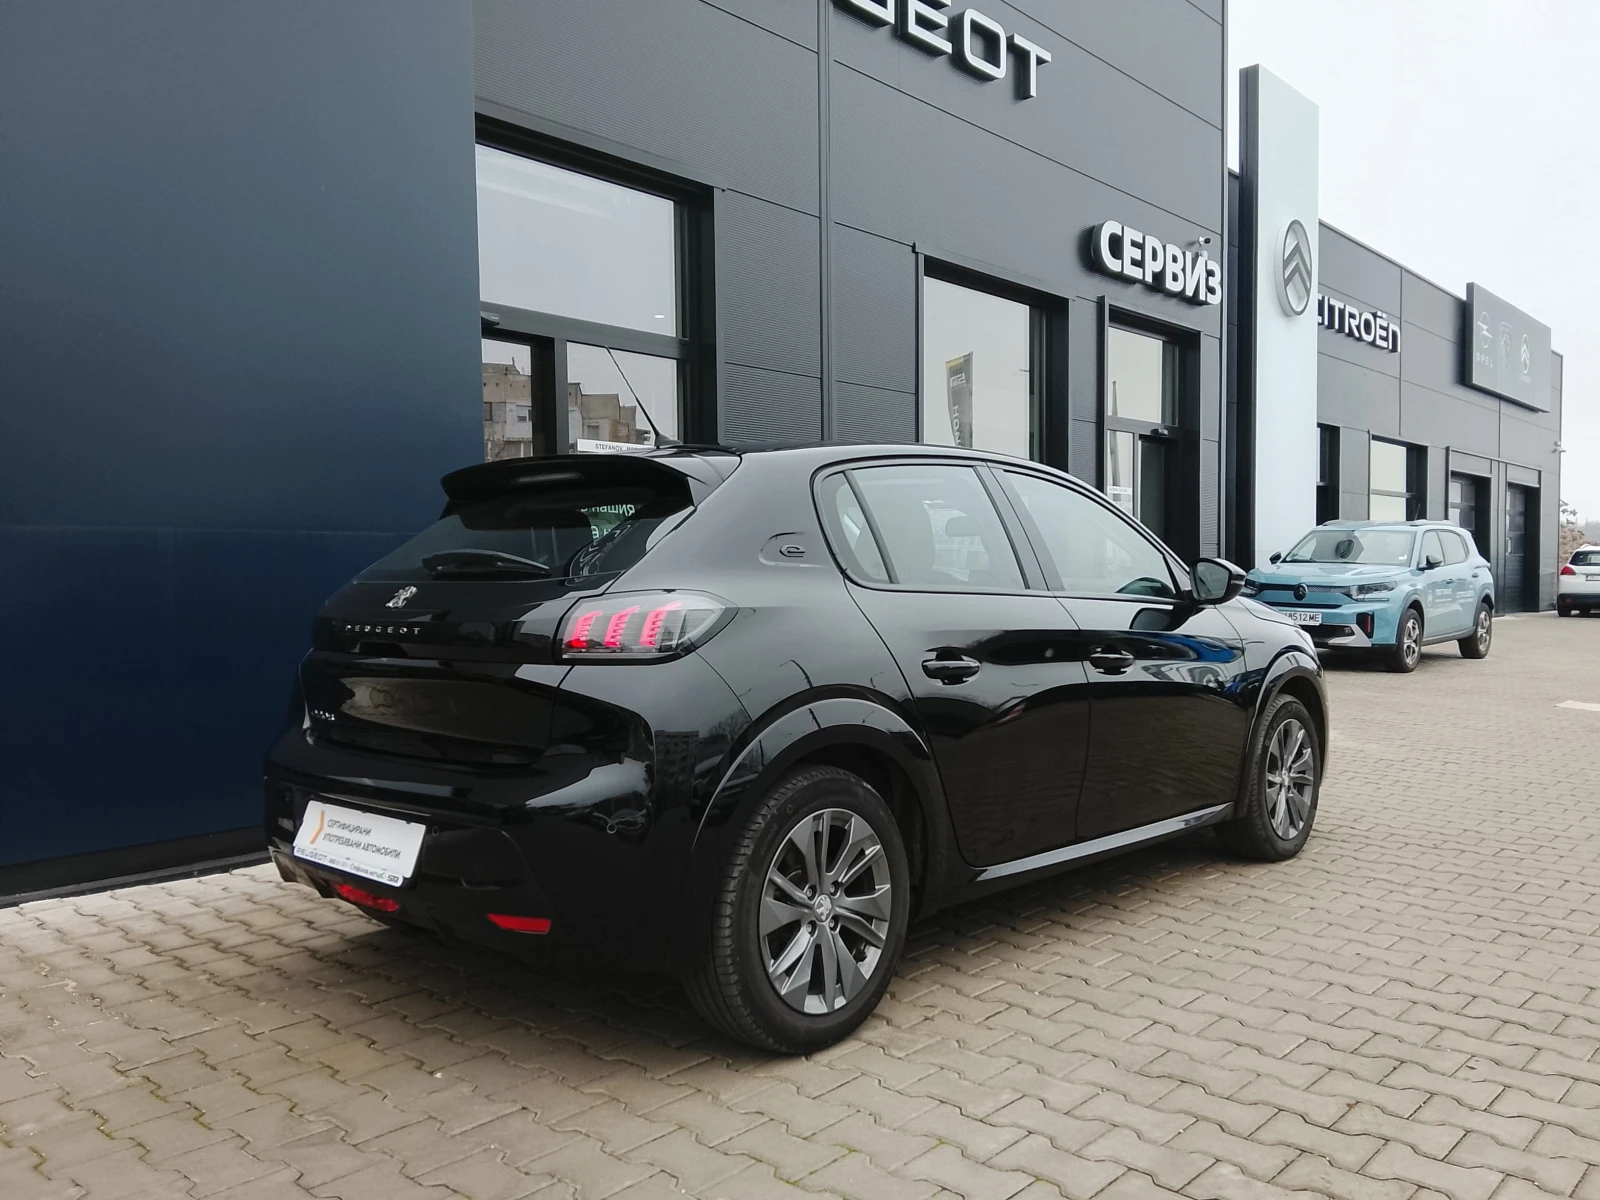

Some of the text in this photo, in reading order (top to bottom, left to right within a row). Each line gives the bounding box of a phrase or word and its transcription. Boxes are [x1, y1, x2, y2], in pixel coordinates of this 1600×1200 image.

[1100, 220, 1221, 305] СЕРВИЗ
[595, 443, 623, 452] STEFANOV
[345, 624, 420, 635] PEUGEOT
[327, 818, 372, 837] СЕРТИФИЦИРАНИ
[322, 832, 402, 860] УПОТРЕБЯВАНИ АВТОМОБИЛИ
